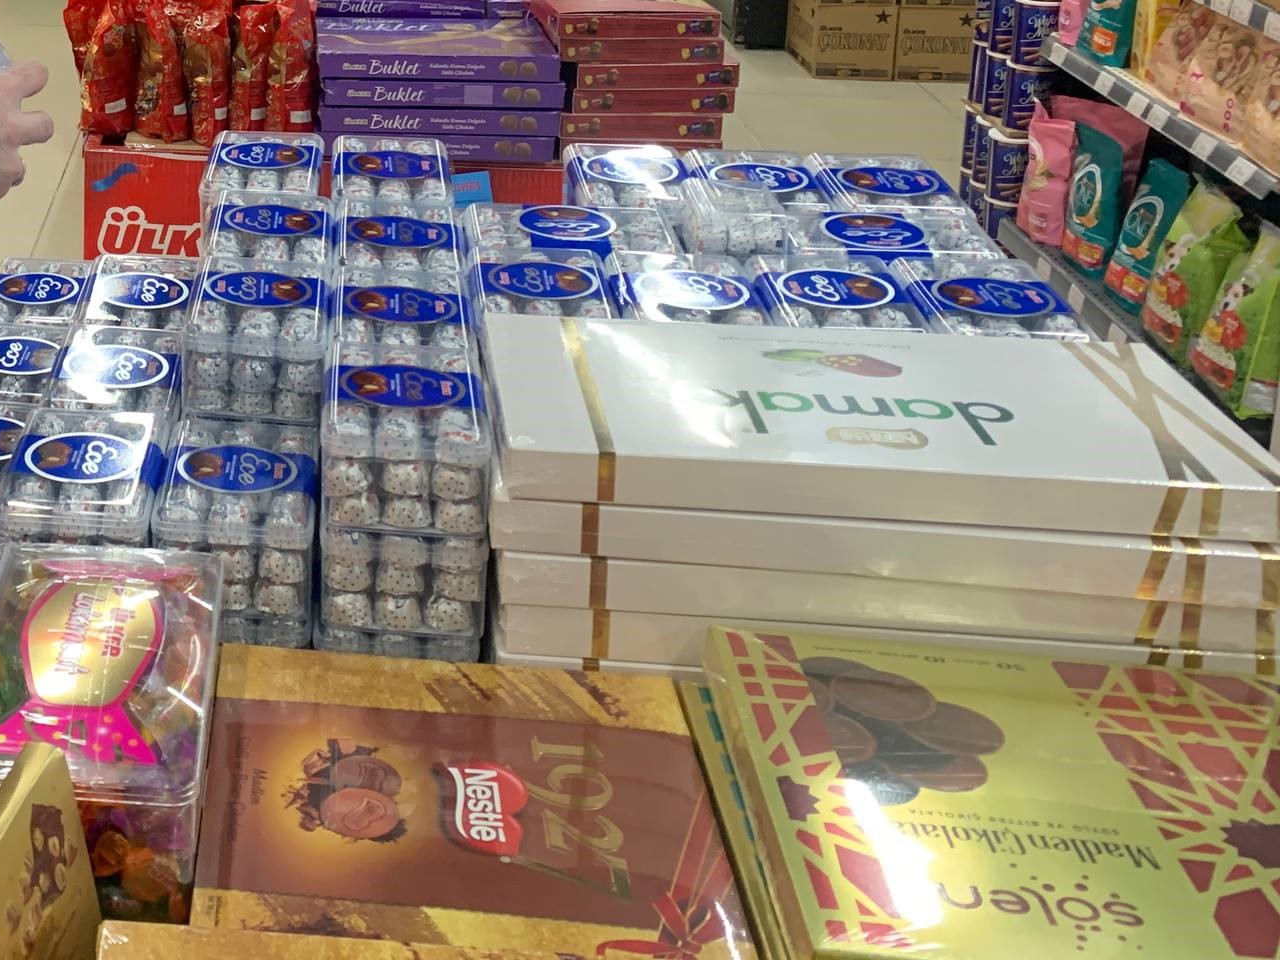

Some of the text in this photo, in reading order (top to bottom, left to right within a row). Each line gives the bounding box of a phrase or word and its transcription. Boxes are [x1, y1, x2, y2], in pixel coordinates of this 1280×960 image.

[338, 0, 386, 14] Buklet
[820, 32, 890, 53] ÇOKONAT
[369, 59, 421, 76] Buklet
[373, 85, 425, 102] Buklet
[370, 114, 422, 130] Buklet
[242, 145, 266, 165] Ece
[754, 166, 785, 189] Ece
[98, 206, 201, 257] ÜLK
[246, 207, 271, 231] Ece
[845, 229, 912, 243] Ece
[34, 277, 62, 300] Ece
[141, 278, 169, 303] Ece
[229, 275, 257, 302] Ece
[513, 267, 545, 292] Ece
[804, 274, 841, 302] Ece
[115, 351, 147, 381] Ece
[712, 389, 1015, 446] damak
[82, 439, 118, 475] Ece
[238, 452, 272, 487] Ece
[464, 767, 507, 843] Nestlé
[514, 735, 632, 900] 1927
[1027, 829, 1162, 871] Madlen
